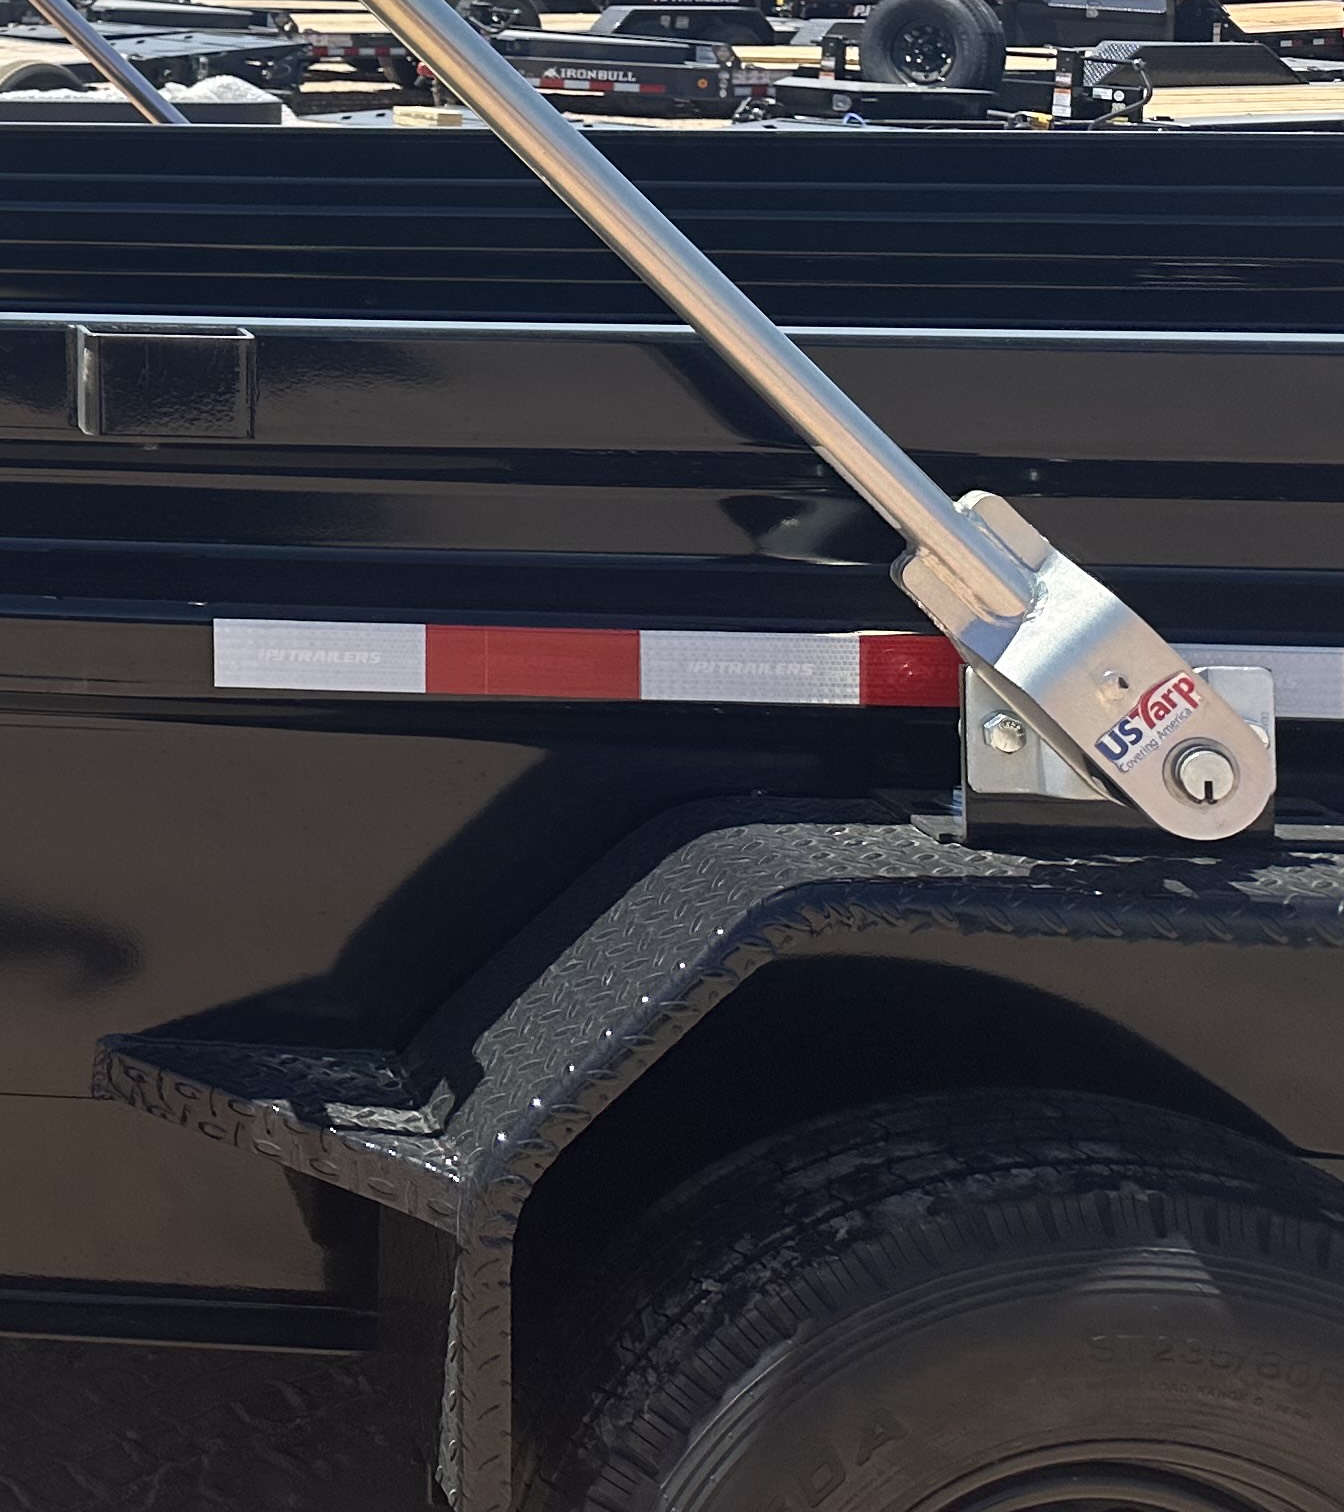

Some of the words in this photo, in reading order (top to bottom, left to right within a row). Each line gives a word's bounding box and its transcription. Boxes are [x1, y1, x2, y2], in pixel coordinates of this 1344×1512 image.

[853, 4, 873, 17] PJ
[1120, 738, 1161, 774] Covering
[1157, 707, 1193, 741] America
